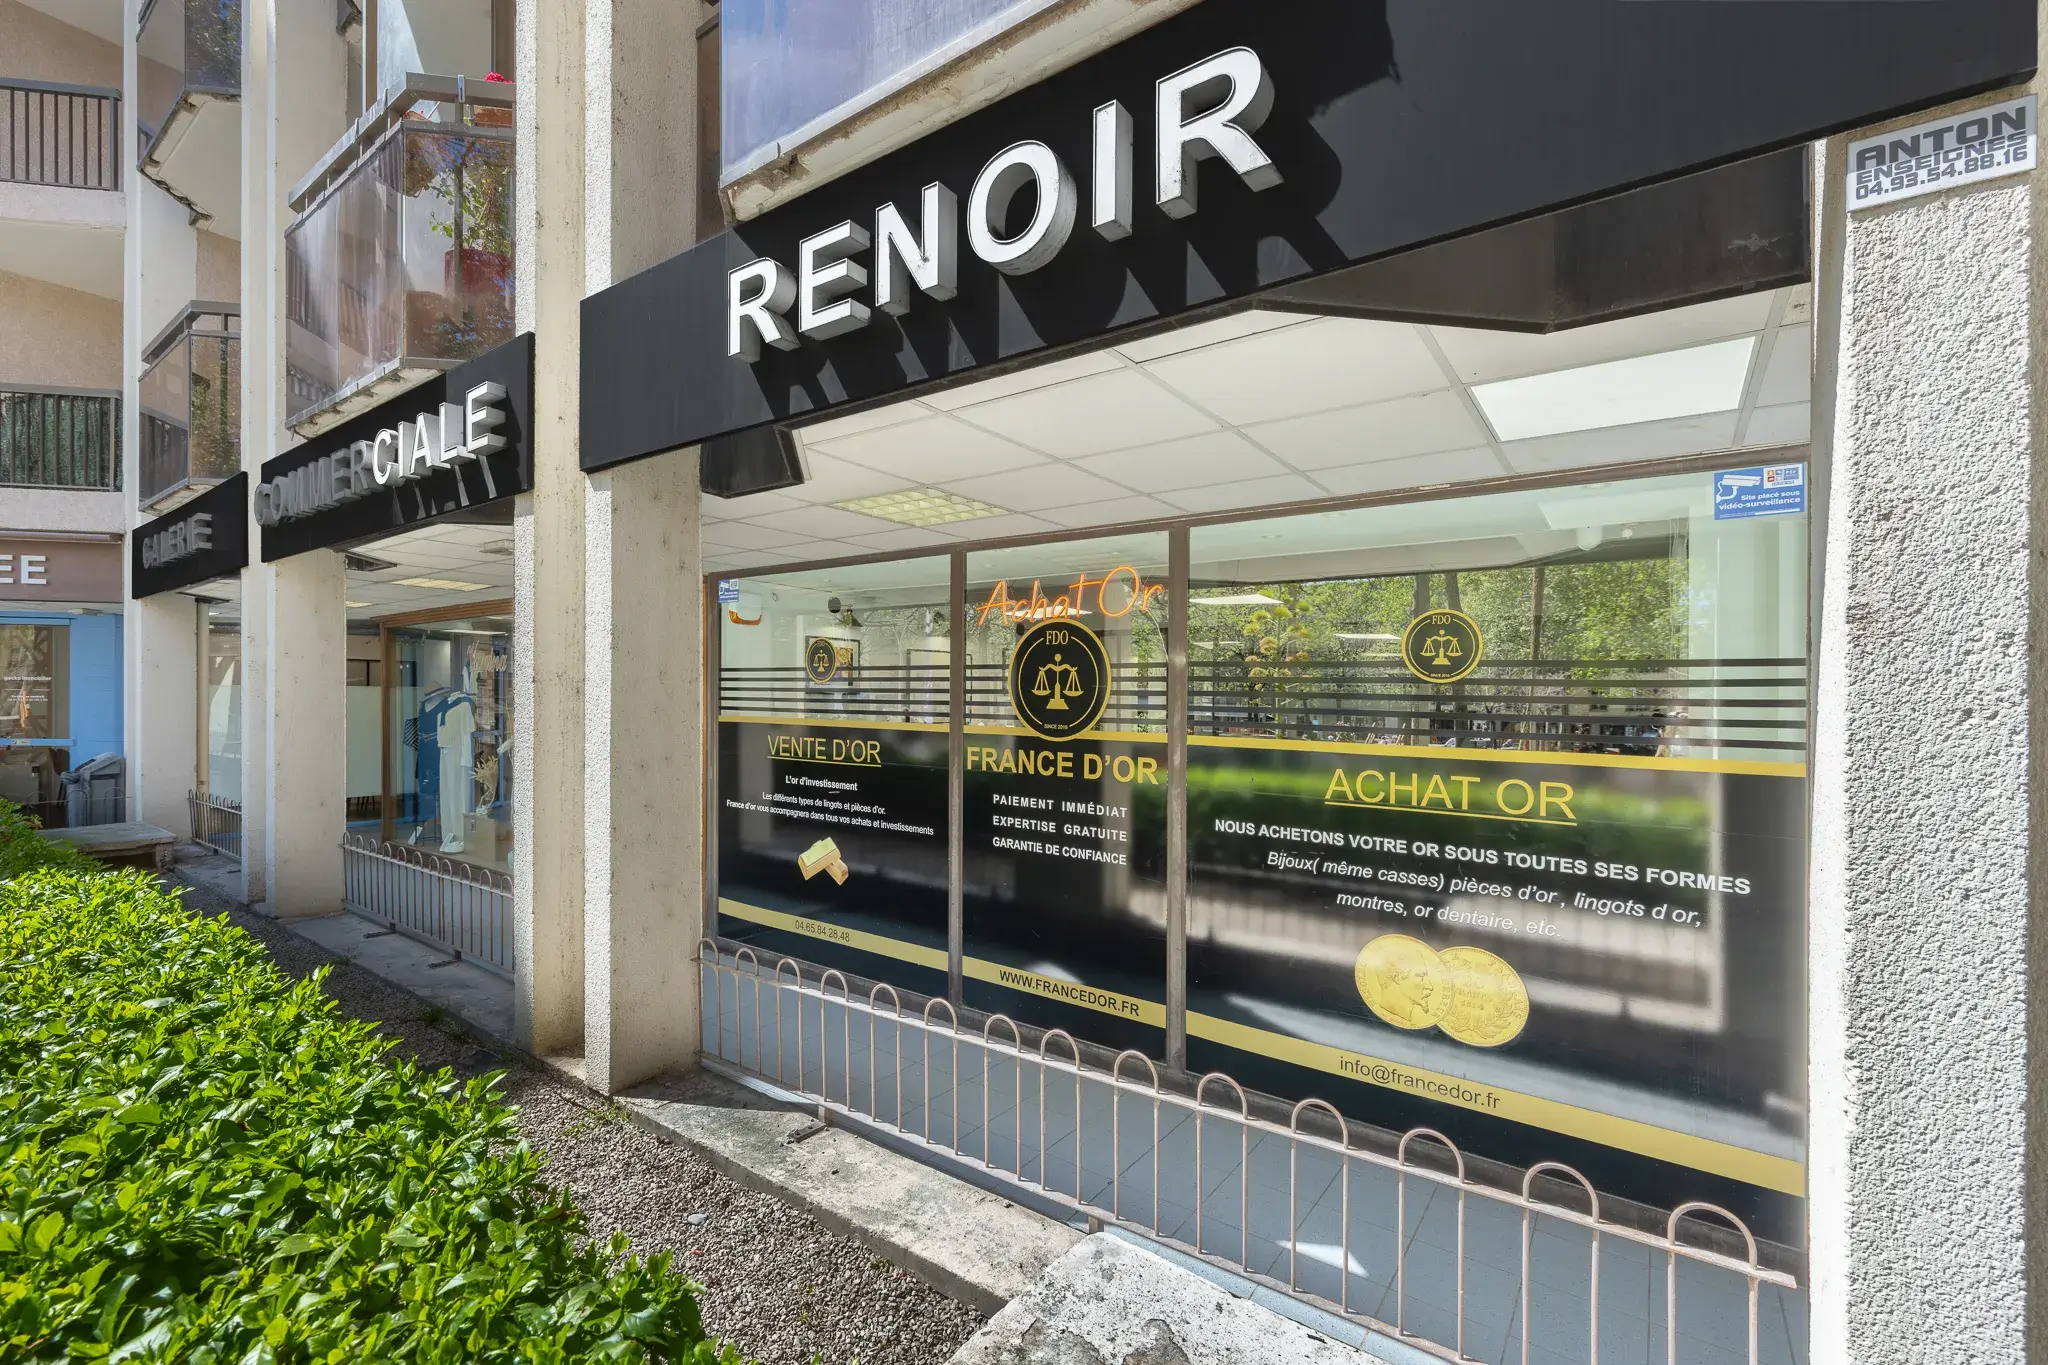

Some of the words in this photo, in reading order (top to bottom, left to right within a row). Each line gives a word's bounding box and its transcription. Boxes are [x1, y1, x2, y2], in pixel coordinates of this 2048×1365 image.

[1856, 106, 2026, 172] ANTON
[1856, 131, 2028, 186] ENSEIGNES
[1856, 145, 2028, 200] 04.93.54.88.16
[727, 46, 1284, 363] RENOIR
[254, 380, 508, 527] COMMERCIALE
[1719, 497, 1801, 510] vidéo-surveillance
[1758, 491, 1779, 500] placé
[142, 513, 212, 569] GALERIE
[976, 573, 1103, 627] Achat
[1099, 565, 1164, 618] Or
[1045, 630, 1069, 645] FDO
[1432, 615, 1451, 624] FDO
[767, 735, 826, 760] VENTE
[833, 740, 881, 763] D'OR
[966, 746, 1073, 777] FRANCE
[1084, 753, 1159, 785] D'OR
[762, 792, 772, 800] Les
[799, 796, 814, 806] types
[814, 799, 823, 807] de
[823, 799, 842, 809] lingots
[844, 802, 850, 810] et
[851, 802, 871, 812] pièces
[872, 805, 886, 814] d'or.
[785, 775, 798, 785] L'or
[799, 776, 858, 791] d'investissement
[1325, 768, 1480, 810] ACHAT
[1496, 778, 1577, 819] OR
[726, 799, 744, 809] France
[745, 802, 756, 810] d'or
[770, 806, 809, 818] accompagnera
[810, 811, 824, 820] dans
[825, 813, 838, 822] tous
[839, 816, 850, 824] vos
[851, 818, 871, 827] achats
[873, 820, 880, 828] et
[881, 820, 934, 835] investissements
[993, 794, 1054, 810] PAIEMENT
[1062, 801, 1127, 818] IMMÉDIAT
[993, 815, 1056, 833] EXPERTISE
[1064, 824, 1127, 841] GRATUITE
[992, 837, 1043, 854] GARANTIE
[1045, 844, 1060, 856] DE
[1062, 846, 1127, 865] CONFIANCE
[1215, 819, 1256, 836] NOUS
[1258, 824, 1344, 846] ACHETONS
[1349, 834, 1407, 854] VOTRE
[1412, 841, 1440, 858] OR
[1444, 845, 1498, 865] SOUS
[1504, 851, 1588, 875] TOUTES
[1594, 862, 1639, 881] SES
[1646, 867, 1751, 895] FORMES
[1323, 860, 1373, 878] même
[1450, 875, 1512, 898] pièces
[1573, 892, 1645, 917] lingots
[795, 919, 851, 943] 04.65.84.28.48
[1336, 892, 1407, 917] montres,
[1415, 904, 1434, 918] or
[1438, 903, 1518, 934] dentaire,
[1526, 919, 1561, 938] etc.
[1000, 969, 1139, 1017] WWW.FRANCEDOR.FR
[1340, 1055, 1501, 1109] info@francedor.fr
